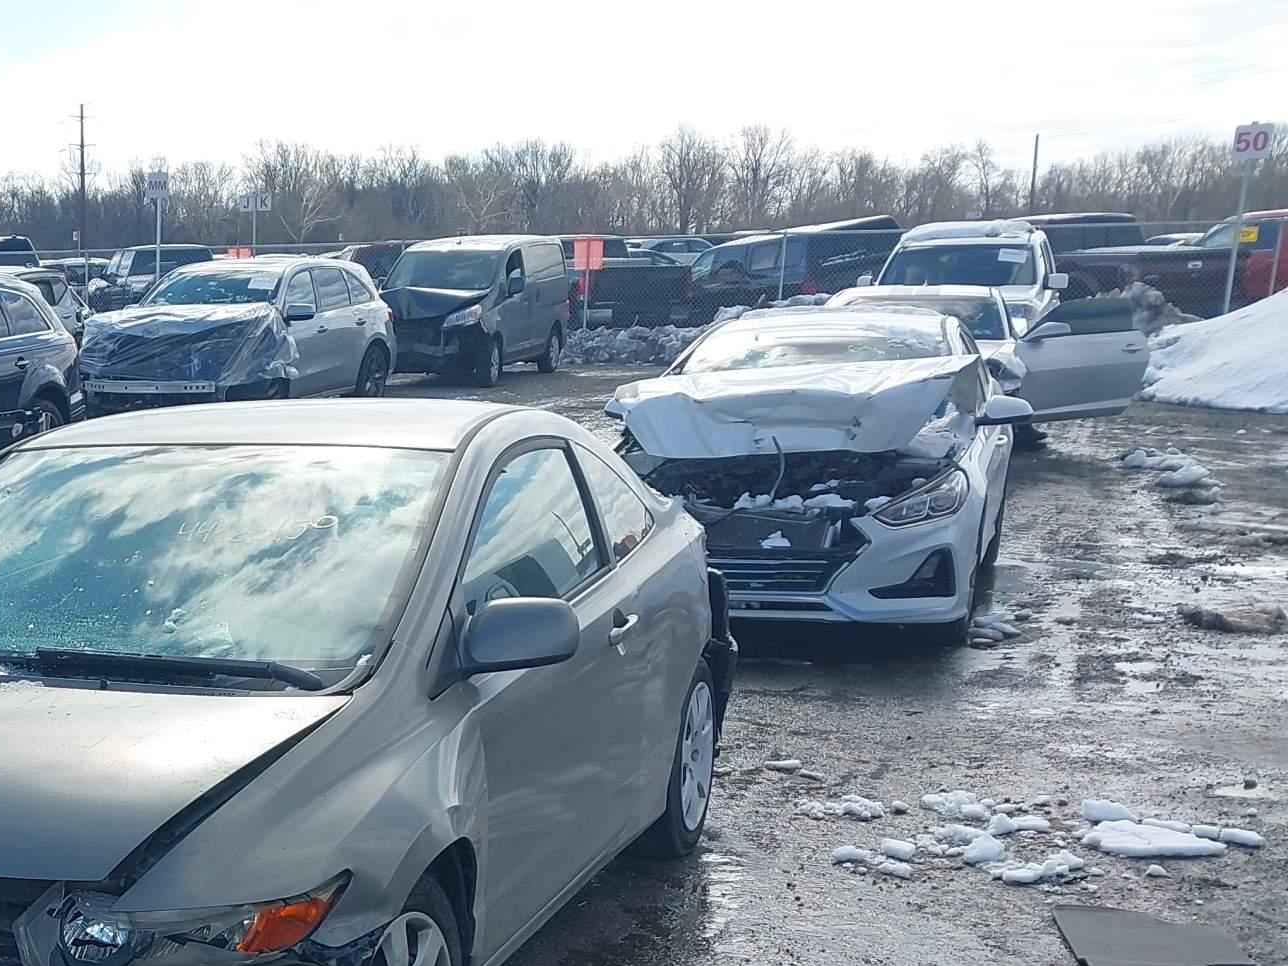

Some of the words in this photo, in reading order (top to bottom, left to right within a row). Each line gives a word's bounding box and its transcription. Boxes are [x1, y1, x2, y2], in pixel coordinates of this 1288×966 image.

[1235, 130, 1269, 153] 50
[148, 179, 167, 191] MM
[243, 197, 251, 209] J
[259, 197, 268, 208] K
[176, 515, 341, 543] 446159
